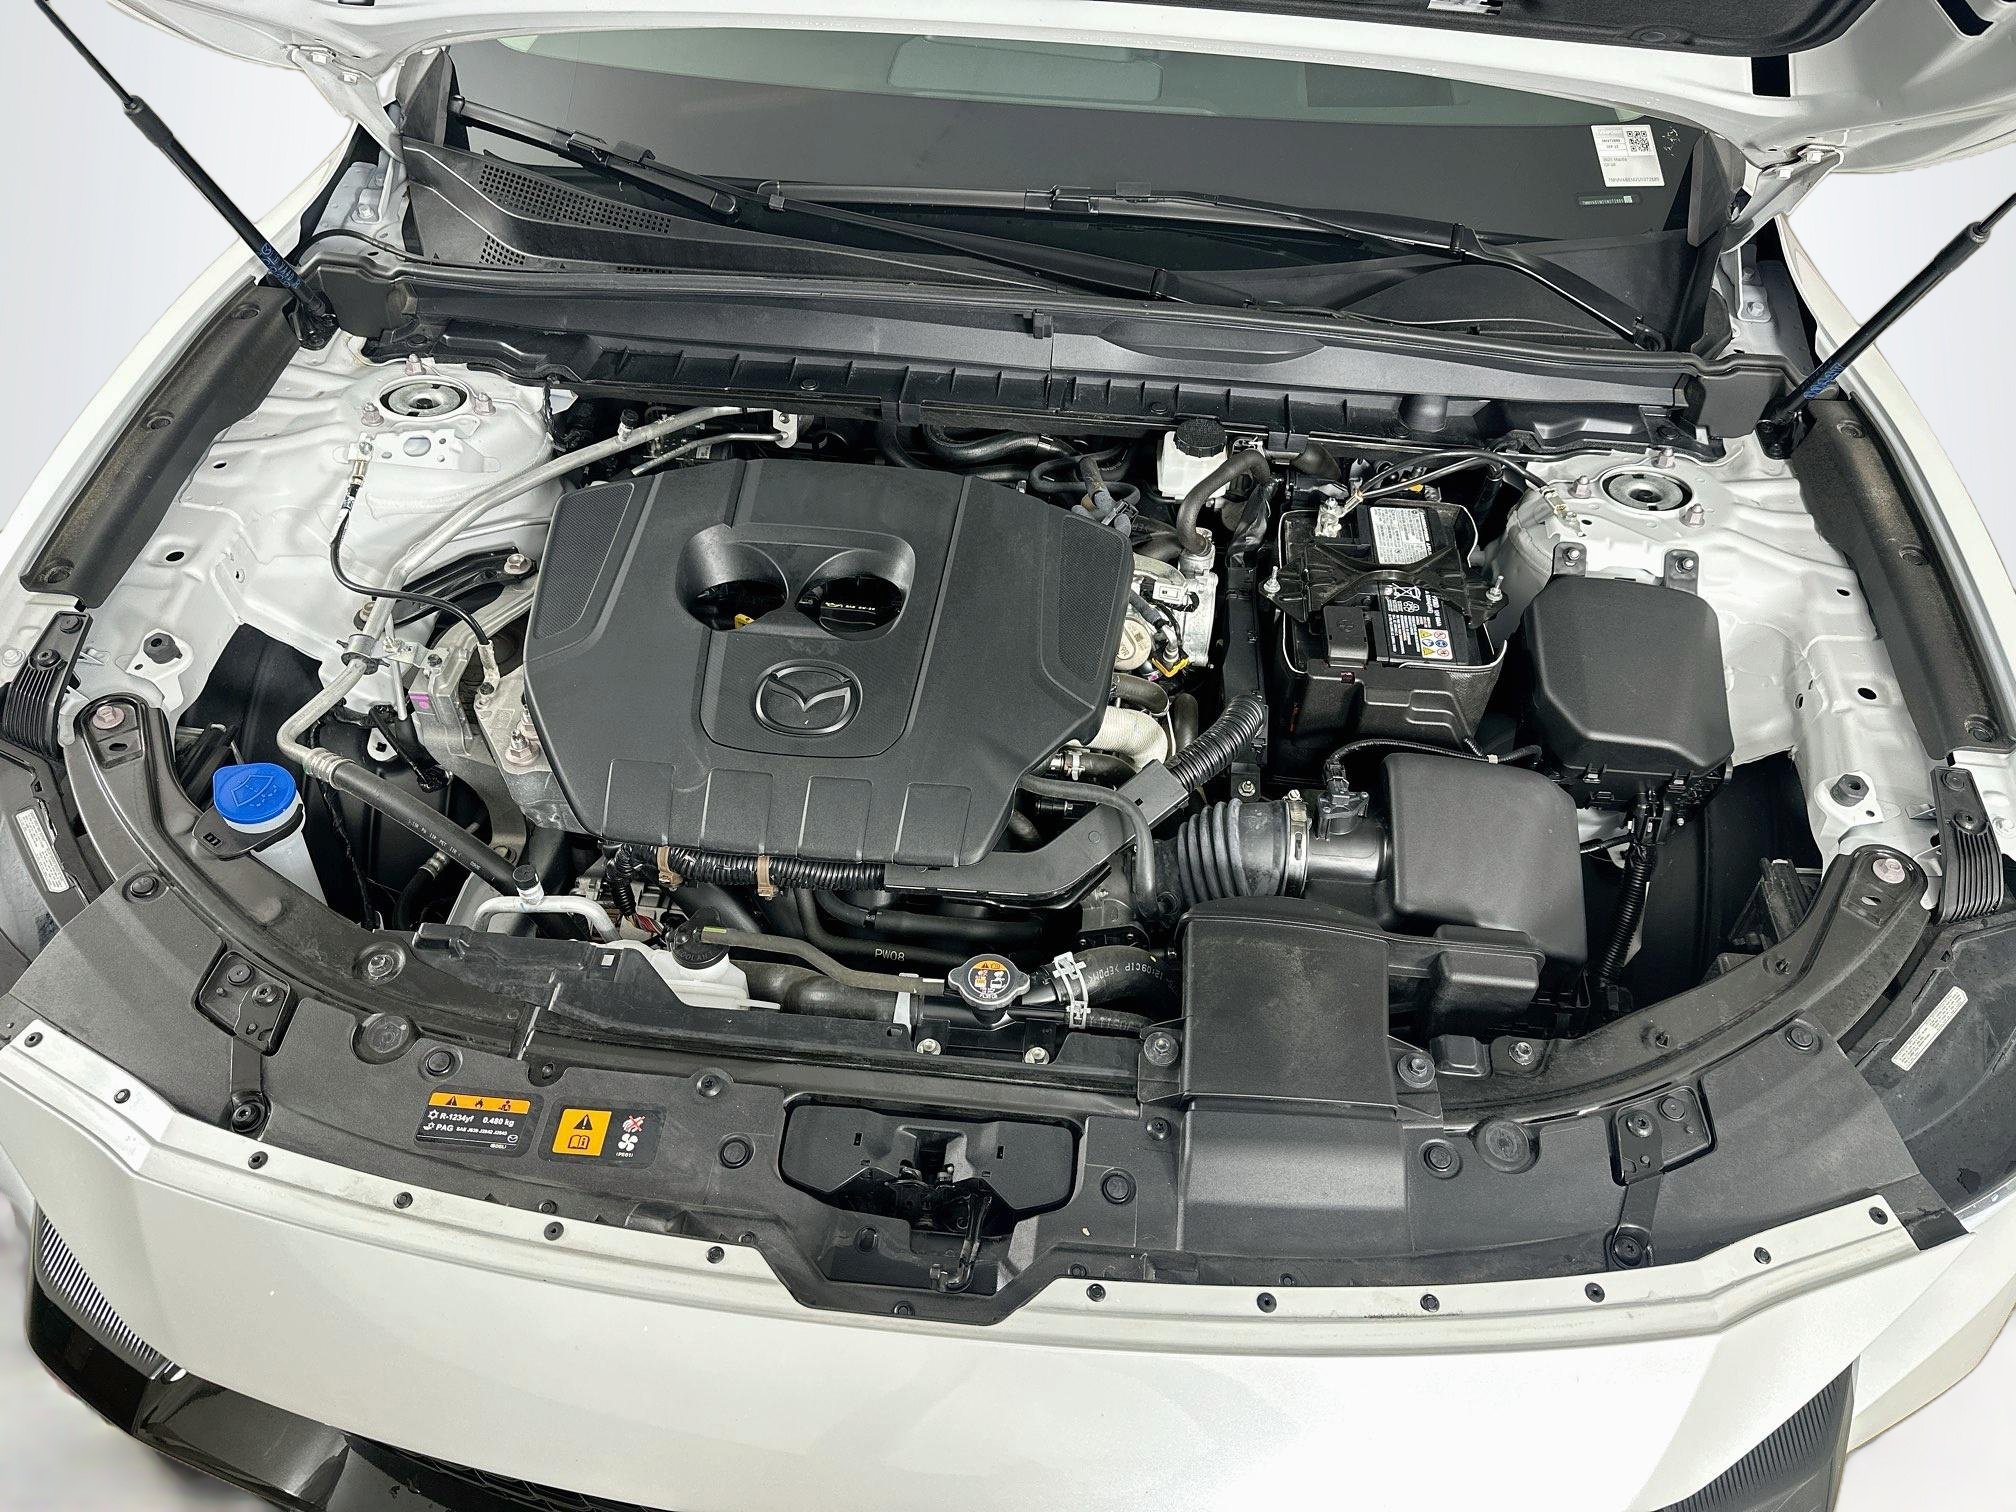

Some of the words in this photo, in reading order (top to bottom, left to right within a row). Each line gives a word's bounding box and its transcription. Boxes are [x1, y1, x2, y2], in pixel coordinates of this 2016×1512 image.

[874, 948, 905, 962] PW08
[439, 1111, 474, 1124] R-1234yf
[482, 1116, 504, 1126] 0.480
[504, 1118, 515, 1128] kg
[435, 1123, 454, 1133] PAG
